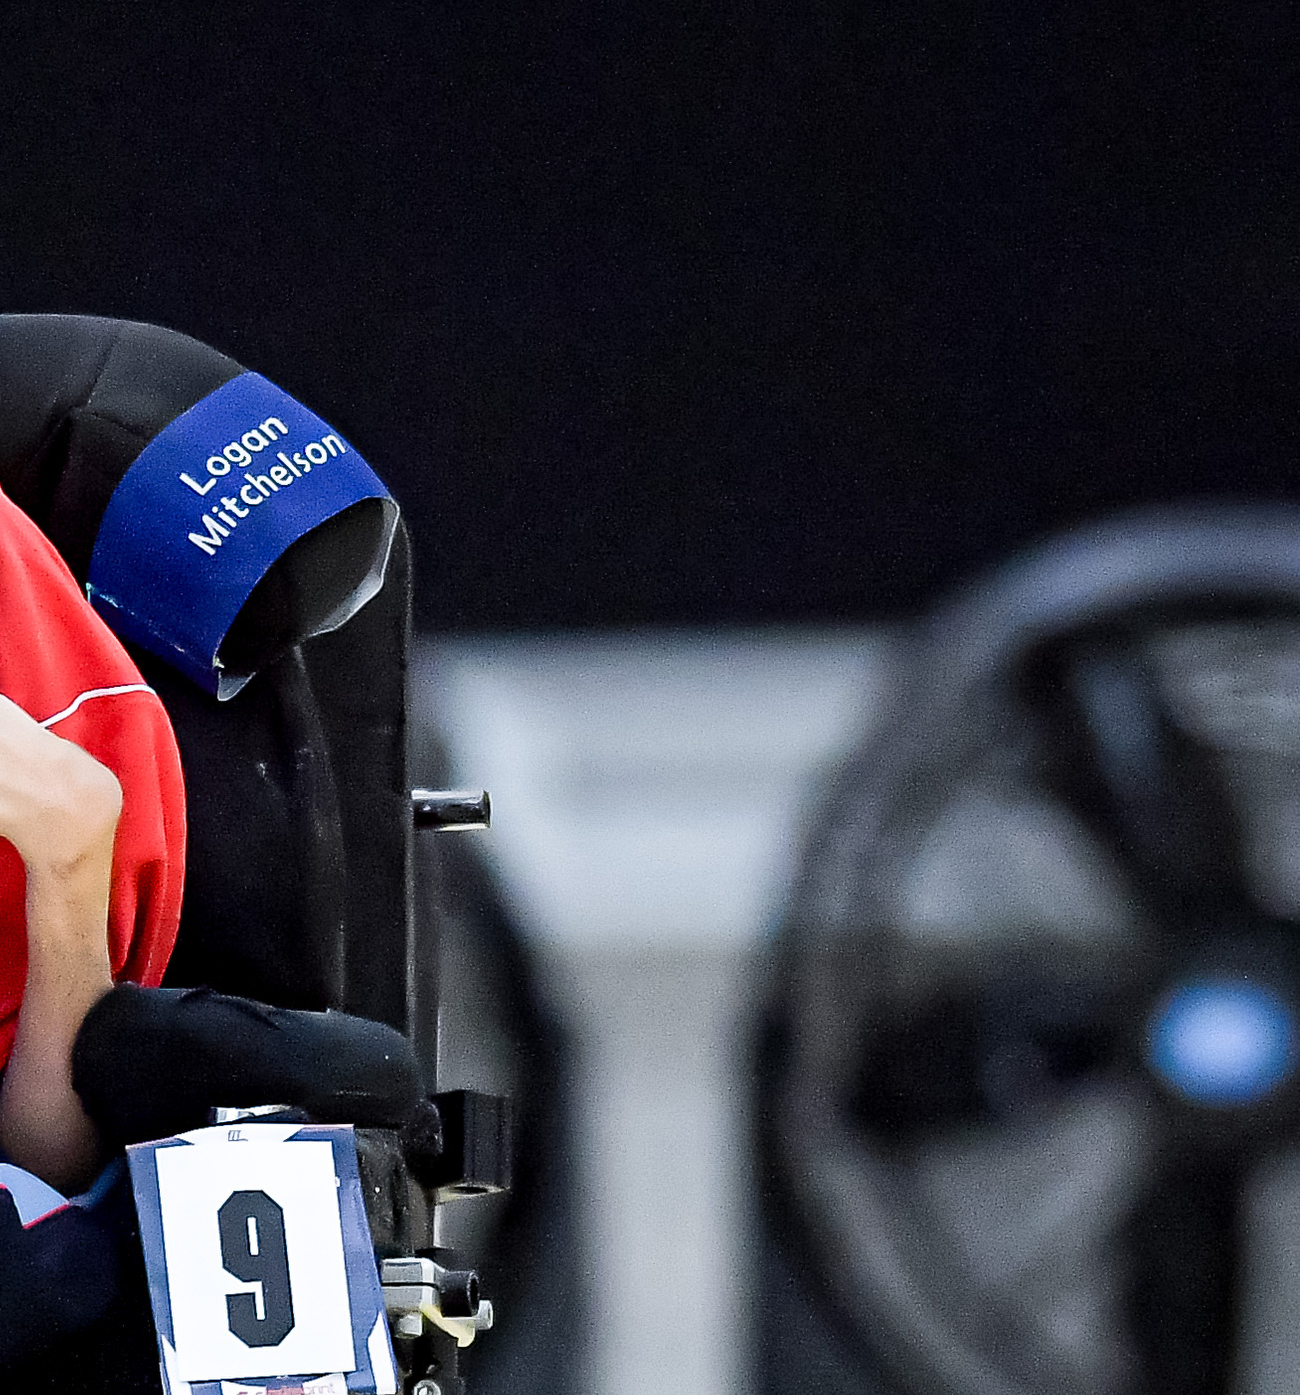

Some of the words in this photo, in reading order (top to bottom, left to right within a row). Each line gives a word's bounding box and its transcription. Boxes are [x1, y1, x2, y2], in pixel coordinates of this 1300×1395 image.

[178, 415, 289, 497] Logan
[188, 432, 347, 556] Mitchelson
[217, 1189, 296, 1349] 9
